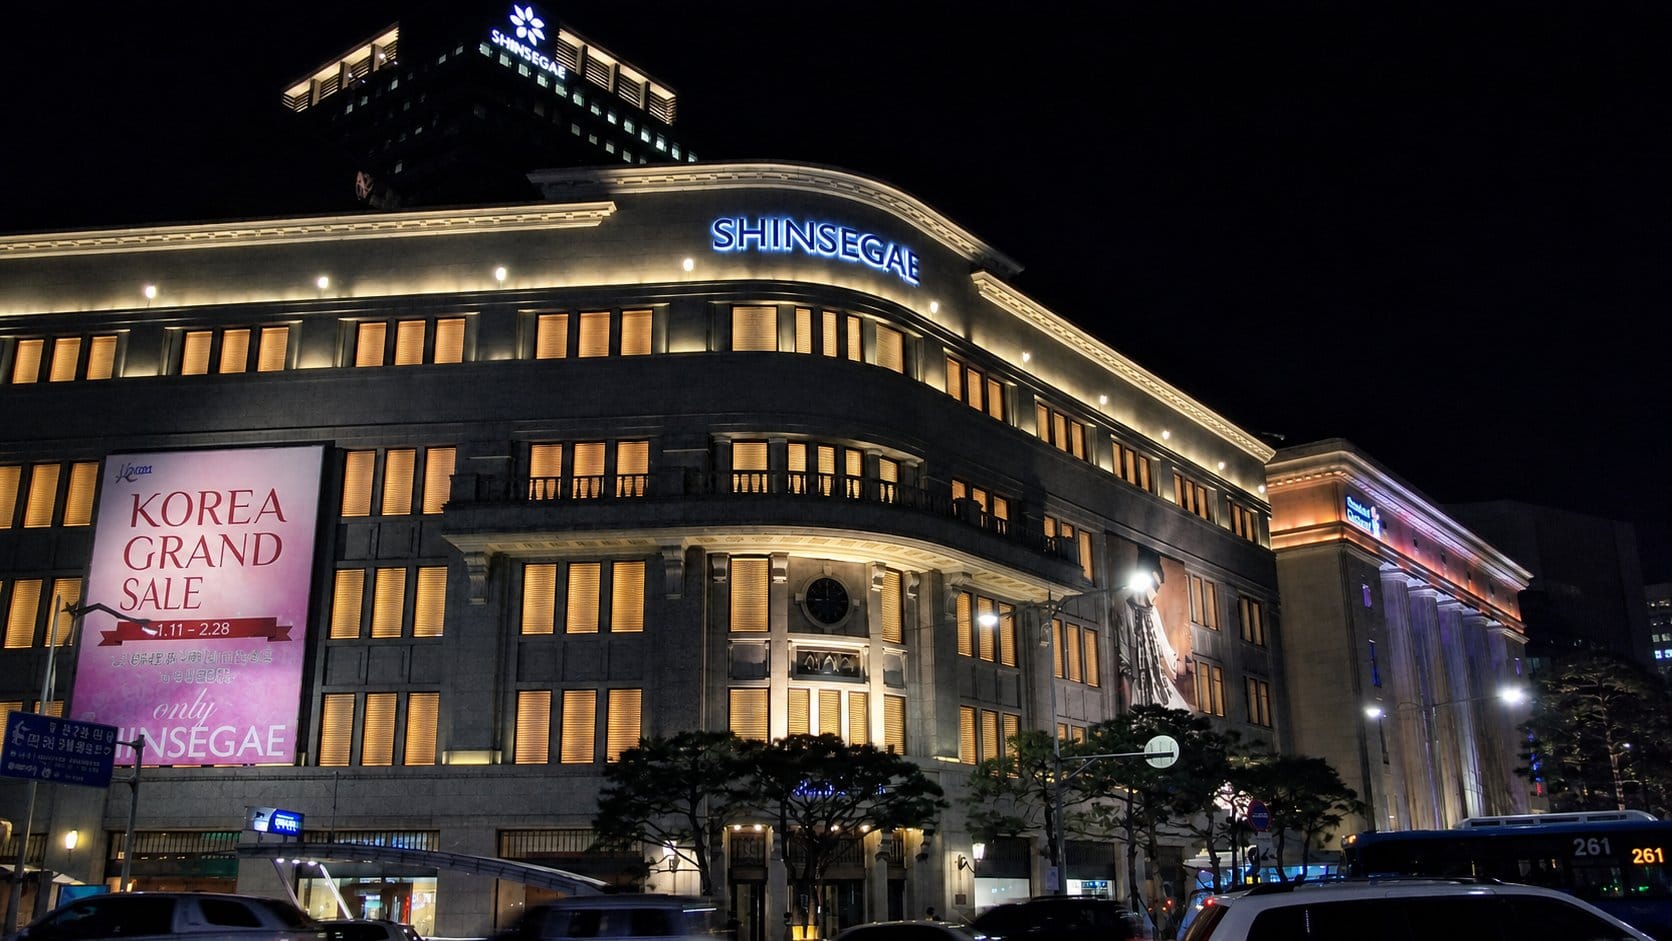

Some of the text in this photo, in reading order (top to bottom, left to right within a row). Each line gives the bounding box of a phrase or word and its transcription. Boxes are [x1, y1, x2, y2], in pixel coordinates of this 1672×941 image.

[491, 29, 566, 80] SHINSEGAE
[712, 217, 920, 287] SHINSEGAE
[130, 488, 287, 528] KOREA
[123, 532, 283, 571] GRAND
[119, 576, 204, 611] SALE
[157, 623, 183, 637] 1.11
[199, 622, 230, 636] 2.28
[153, 688, 217, 729] only
[115, 725, 287, 758] INSEGAE
[1573, 837, 1611, 856] 261
[1631, 847, 1665, 864] 261
